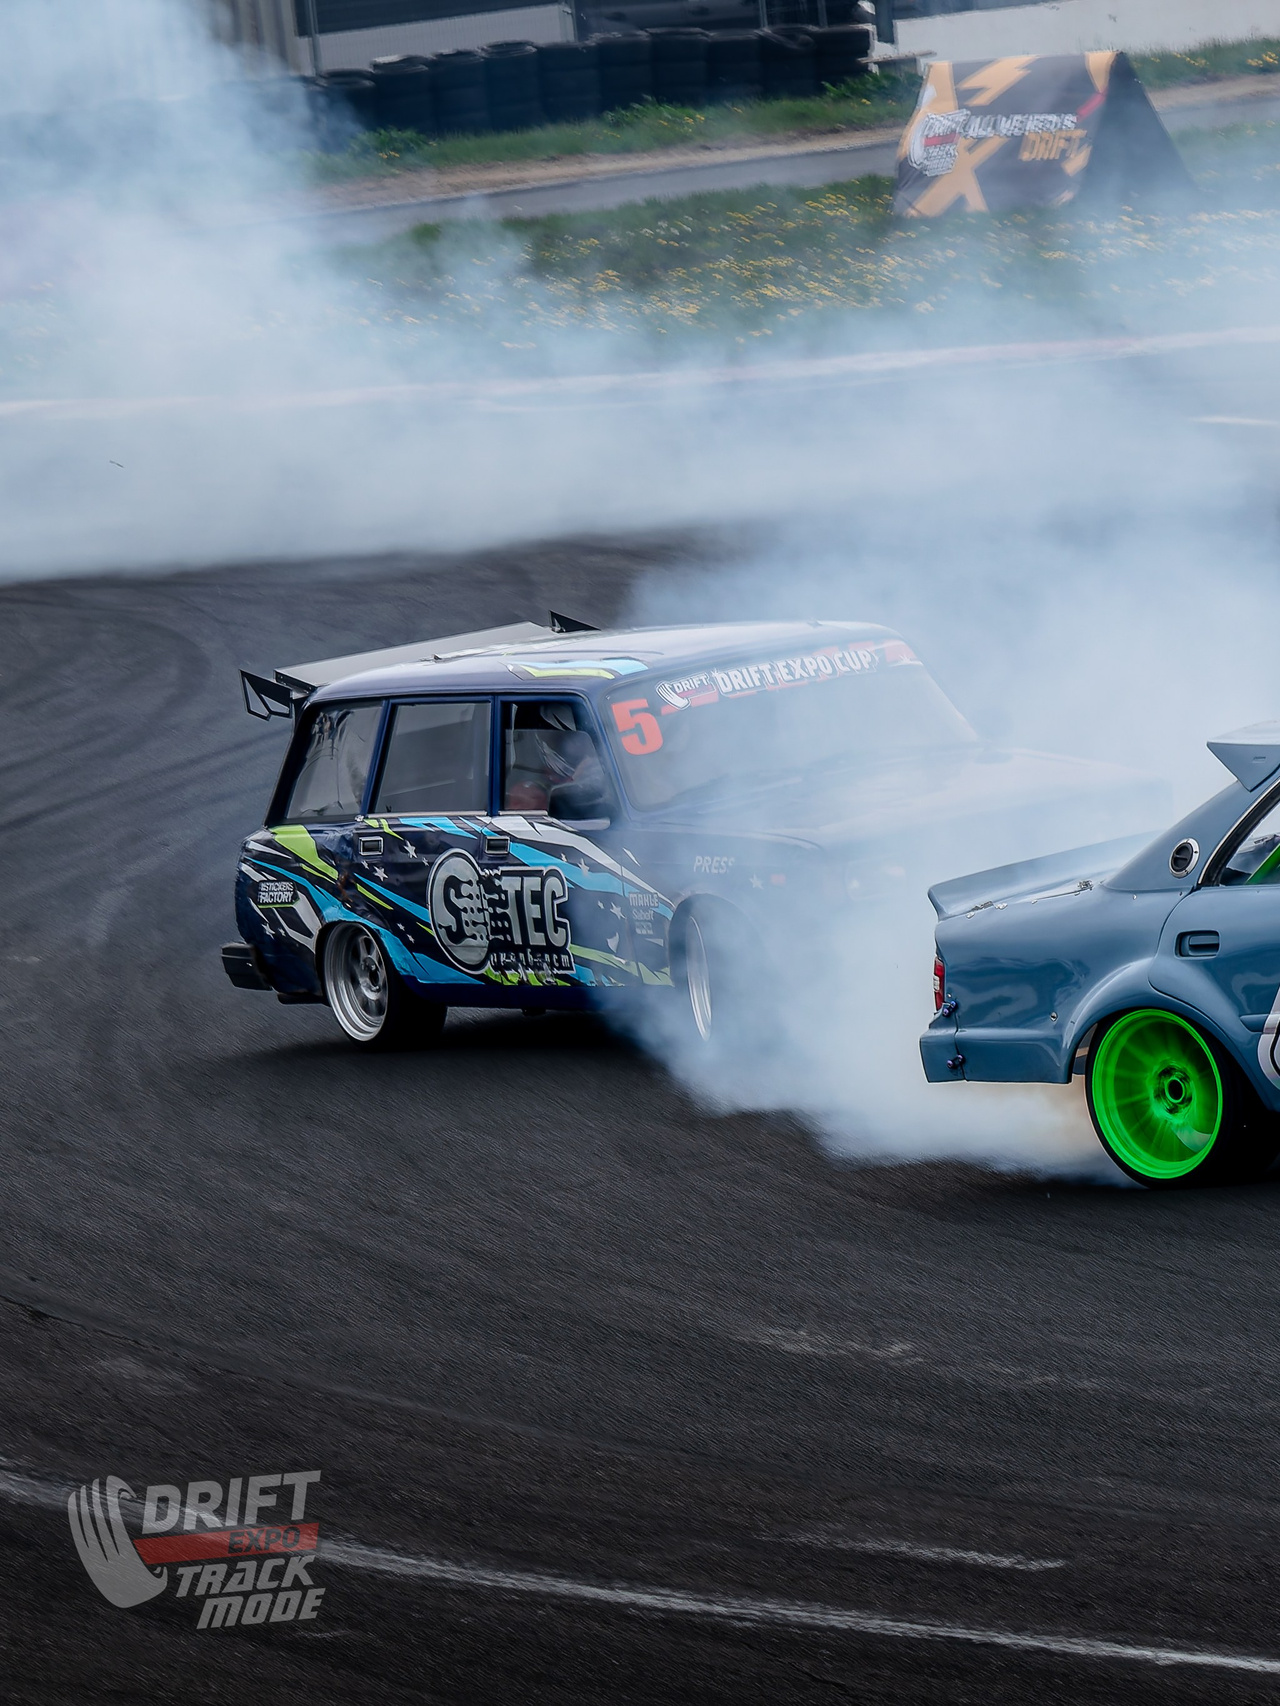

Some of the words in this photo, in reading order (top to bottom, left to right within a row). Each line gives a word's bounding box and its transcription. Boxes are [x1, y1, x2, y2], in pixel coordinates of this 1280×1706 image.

[717, 664, 775, 693] DRIFT
[778, 653, 833, 682] EXPO
[834, 649, 873, 673] CUP
[674, 674, 709, 694] DRIFT
[611, 698, 664, 756] 5
[258, 892, 295, 903] FACTORY
[629, 893, 659, 907] MAHLE
